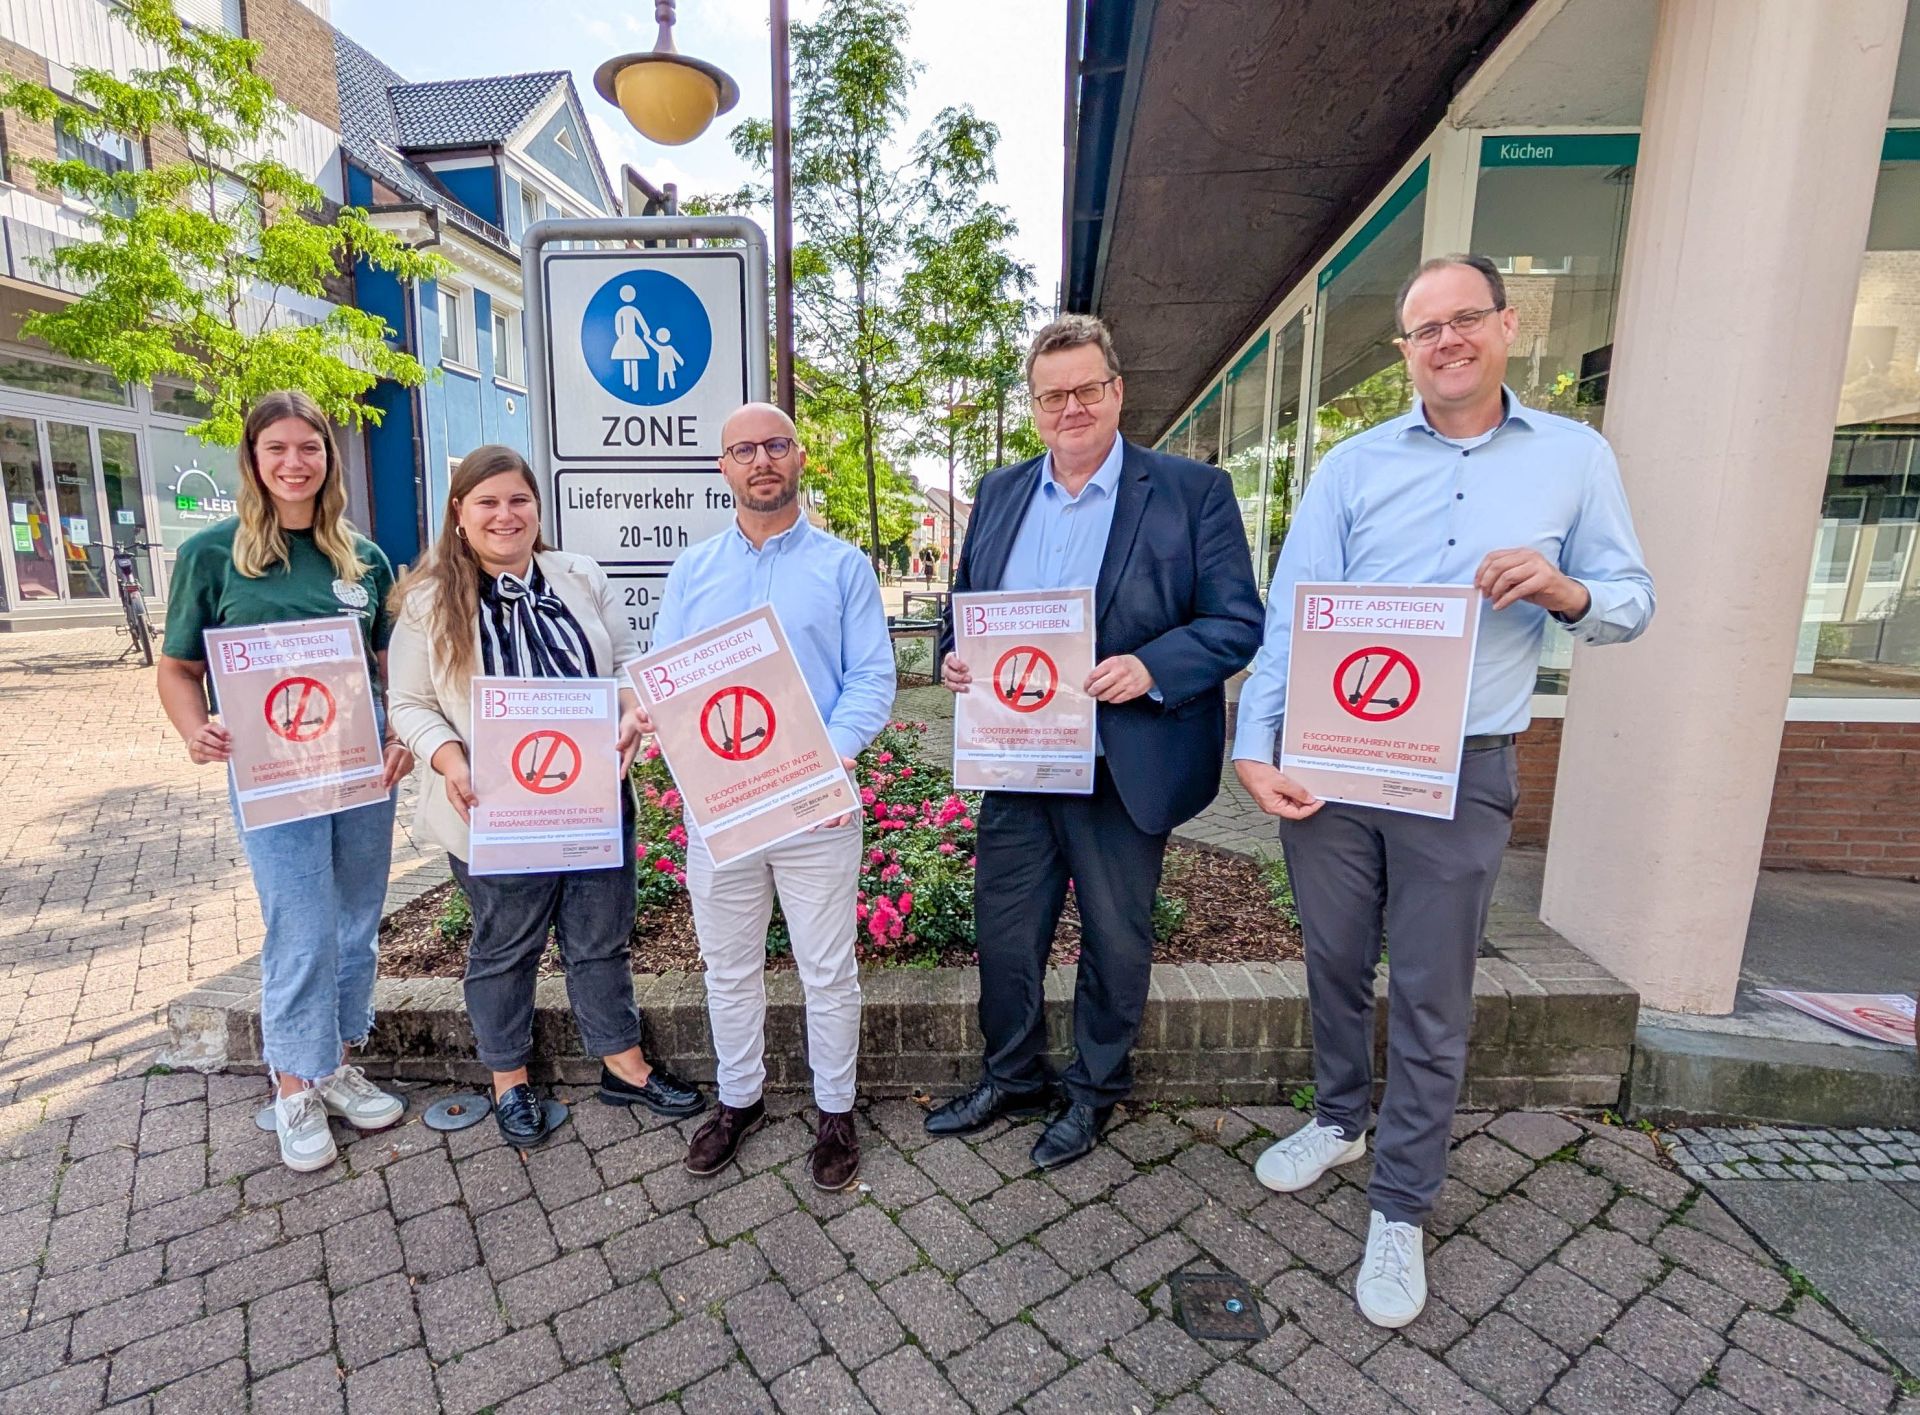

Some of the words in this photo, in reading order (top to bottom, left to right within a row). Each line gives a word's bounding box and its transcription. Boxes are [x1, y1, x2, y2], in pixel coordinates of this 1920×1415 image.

[1500, 143, 1553, 159] Küchen
[602, 416, 698, 447] ZONE
[568, 487, 694, 510] Lieferverkehr
[1009, 604, 1067, 615] ABSTEIGEN
[1307, 597, 1316, 629] BECKUM
[1366, 601, 1444, 613] ABSTEIGEN
[1019, 619, 1070, 630] SCHIEBEN
[1376, 618, 1445, 631] SCHIEBEN
[274, 634, 335, 649] ABSTEIGEN
[693, 629, 753, 663] ABSTEIGEN
[286, 648, 339, 662] SCHIEBEN
[708, 643, 762, 674] SCHIEBEN
[532, 693, 591, 701] ABSTEIGEN
[541, 706, 594, 715] SCHIEBEN
[1303, 732, 1352, 744] E-SCOOTER
[1354, 737, 1391, 748] FAHREN
[1393, 741, 1407, 749] IST
[1408, 742, 1418, 750] IN
[1420, 743, 1440, 753] DER
[704, 779, 748, 804] E-SCOOTER
[748, 767, 779, 786] FAHREN
[780, 762, 791, 772] IST
[792, 758, 802, 767] IN
[802, 750, 818, 762] DER
[489, 809, 533, 818] E-SCOOTER
[534, 808, 565, 816] FAHREN
